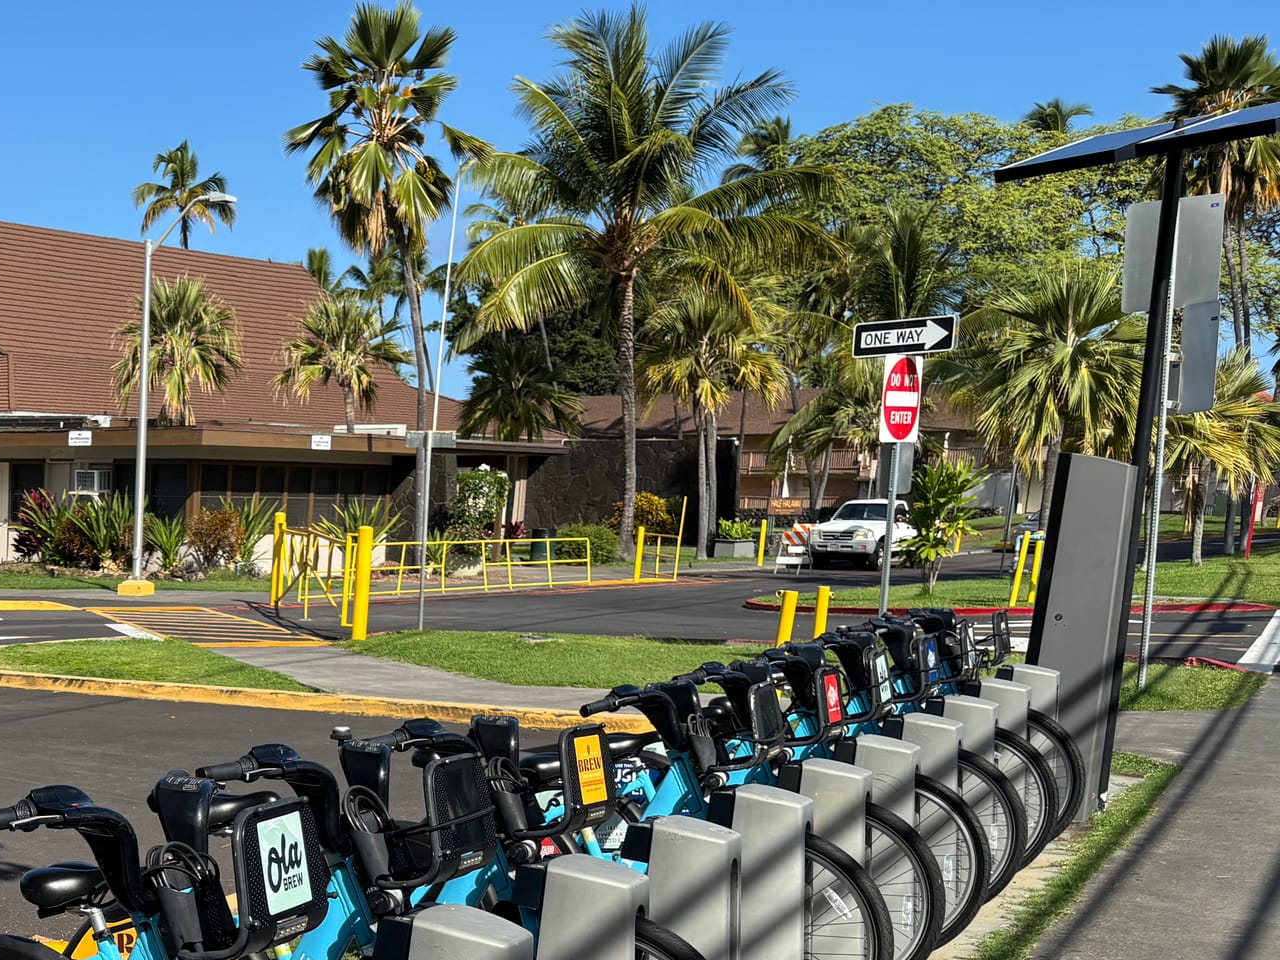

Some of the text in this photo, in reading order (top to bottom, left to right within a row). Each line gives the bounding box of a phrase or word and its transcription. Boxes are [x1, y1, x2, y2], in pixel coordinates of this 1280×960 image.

[864, 328, 924, 347] ONE WAY
[890, 373, 918, 387] DO NOT
[890, 411, 912, 425] ENTER
[578, 757, 602, 772] BREW
[267, 833, 303, 894] Ola
[283, 872, 304, 891] BREW
